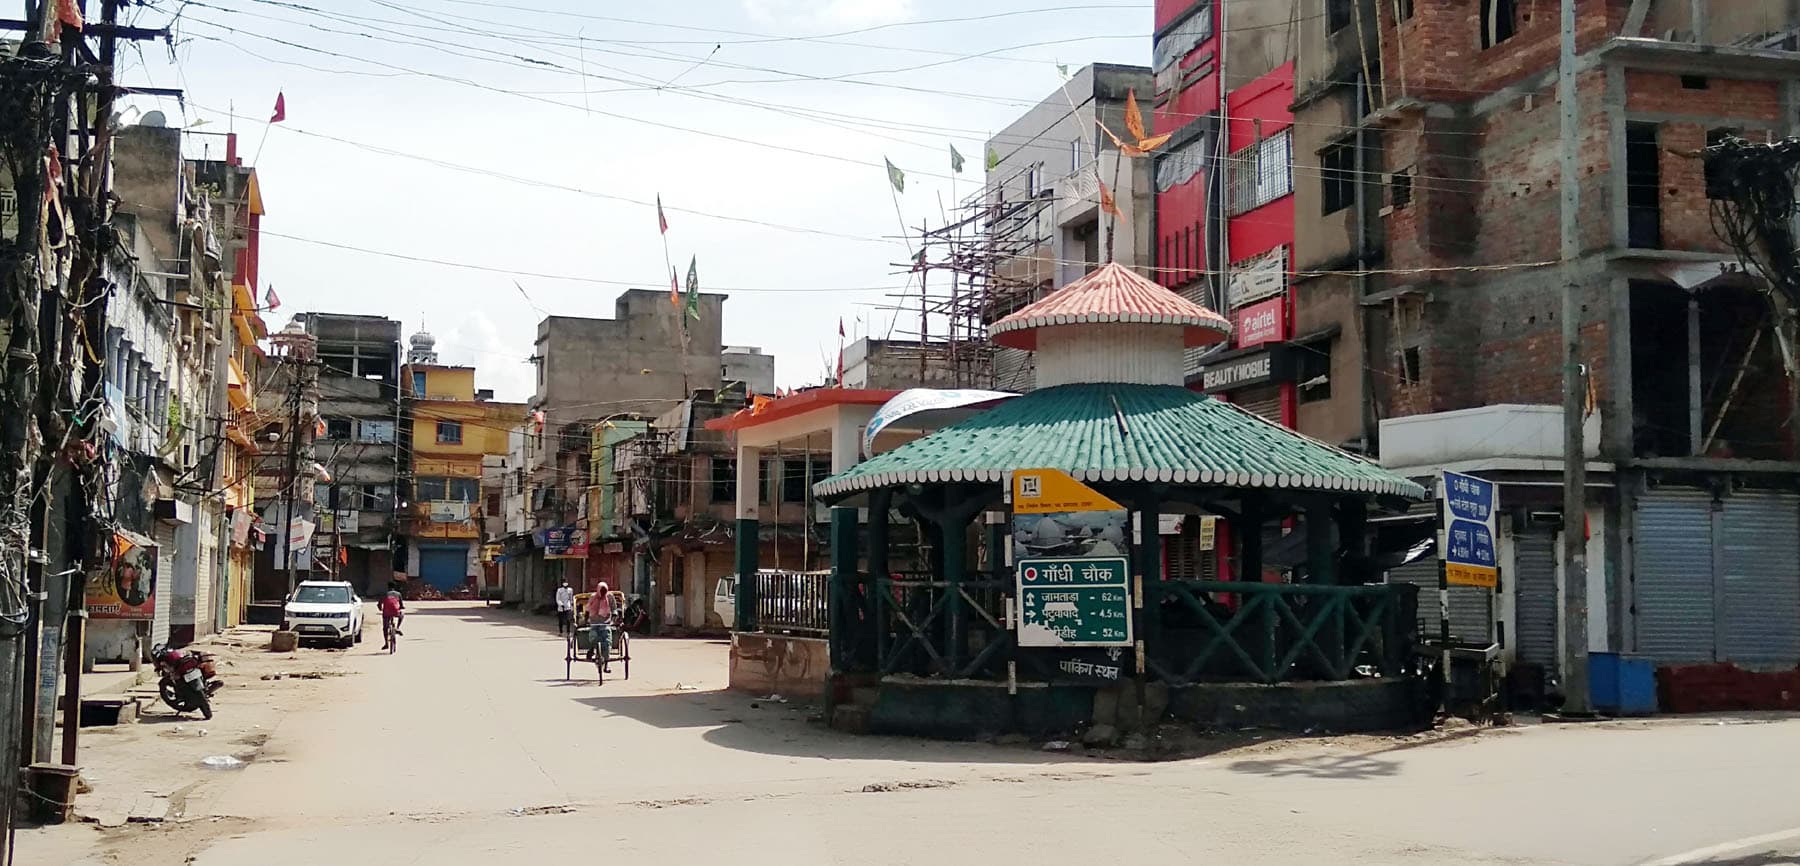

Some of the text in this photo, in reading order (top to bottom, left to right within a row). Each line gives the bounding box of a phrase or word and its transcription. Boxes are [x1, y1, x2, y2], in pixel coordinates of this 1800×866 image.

[1252, 308, 1275, 331] airtel
[1203, 358, 1270, 388] BEAUTY MOBILE
[1041, 564, 1112, 582] गाँधी चौक
[1101, 593, 1112, 602] 62
[1099, 608, 1112, 618] 4.5
[1102, 628, 1113, 638] 52
[1095, 664, 1120, 680] स्थल
